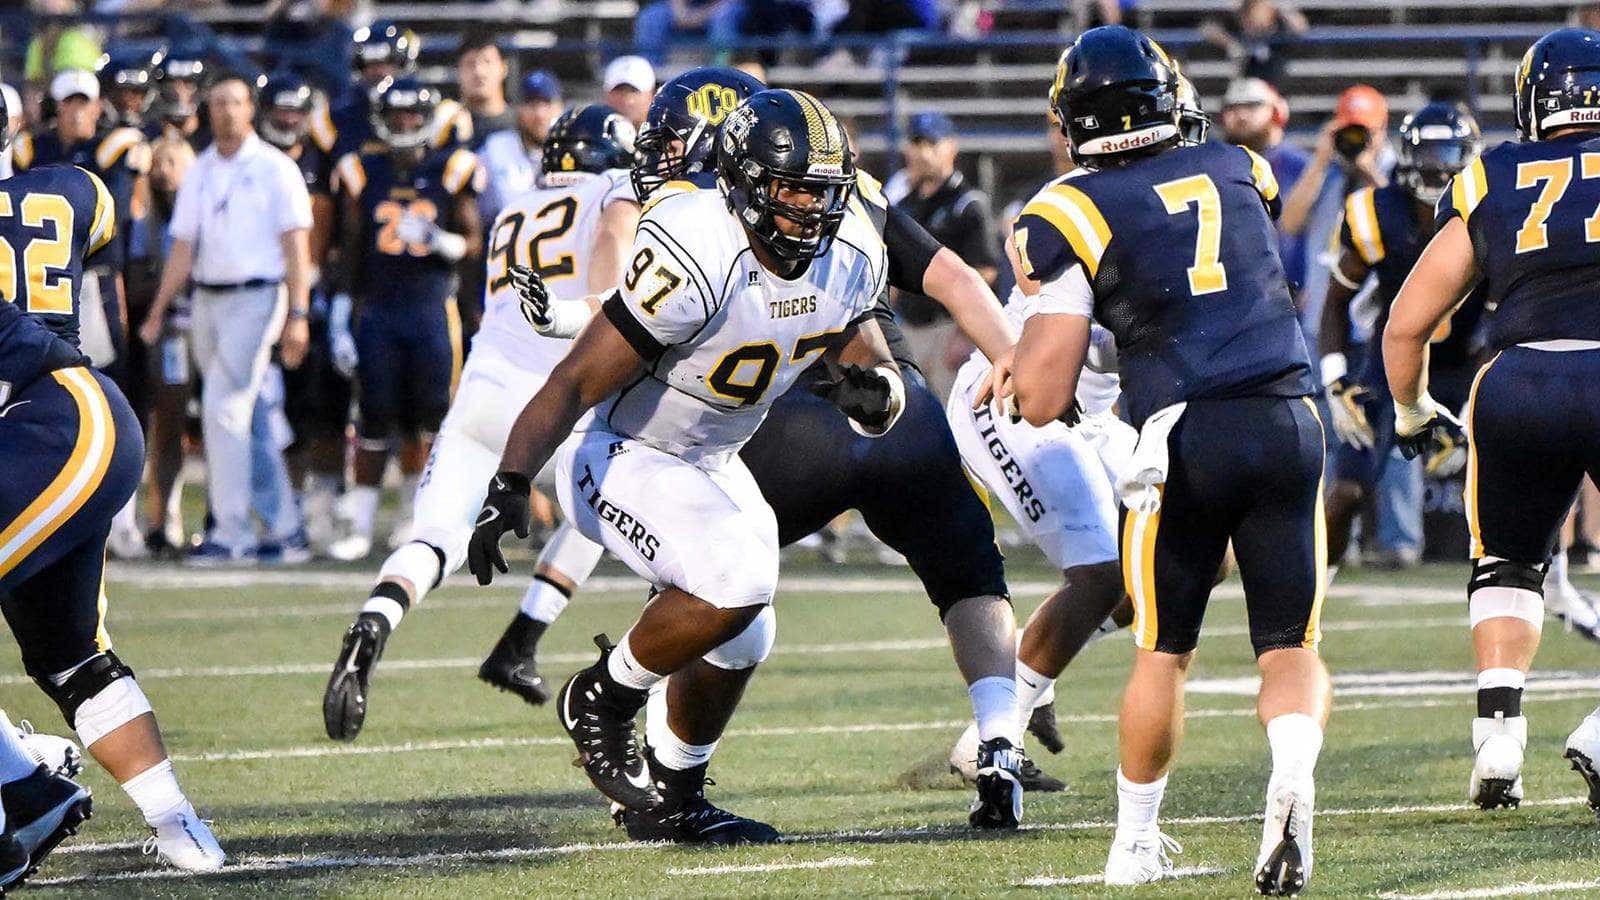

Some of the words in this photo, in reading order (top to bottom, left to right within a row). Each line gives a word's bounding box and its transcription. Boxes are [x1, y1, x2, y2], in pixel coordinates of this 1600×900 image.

[686, 83, 738, 126] UCO
[1121, 115, 1132, 130] 7
[1583, 90, 1600, 105] 7
[489, 194, 580, 296] 92
[1153, 173, 1228, 296] 7
[624, 246, 682, 316] 97
[769, 295, 817, 319] TIGERS
[973, 403, 1046, 522] TIGERS
[577, 463, 661, 562] TIGERS
